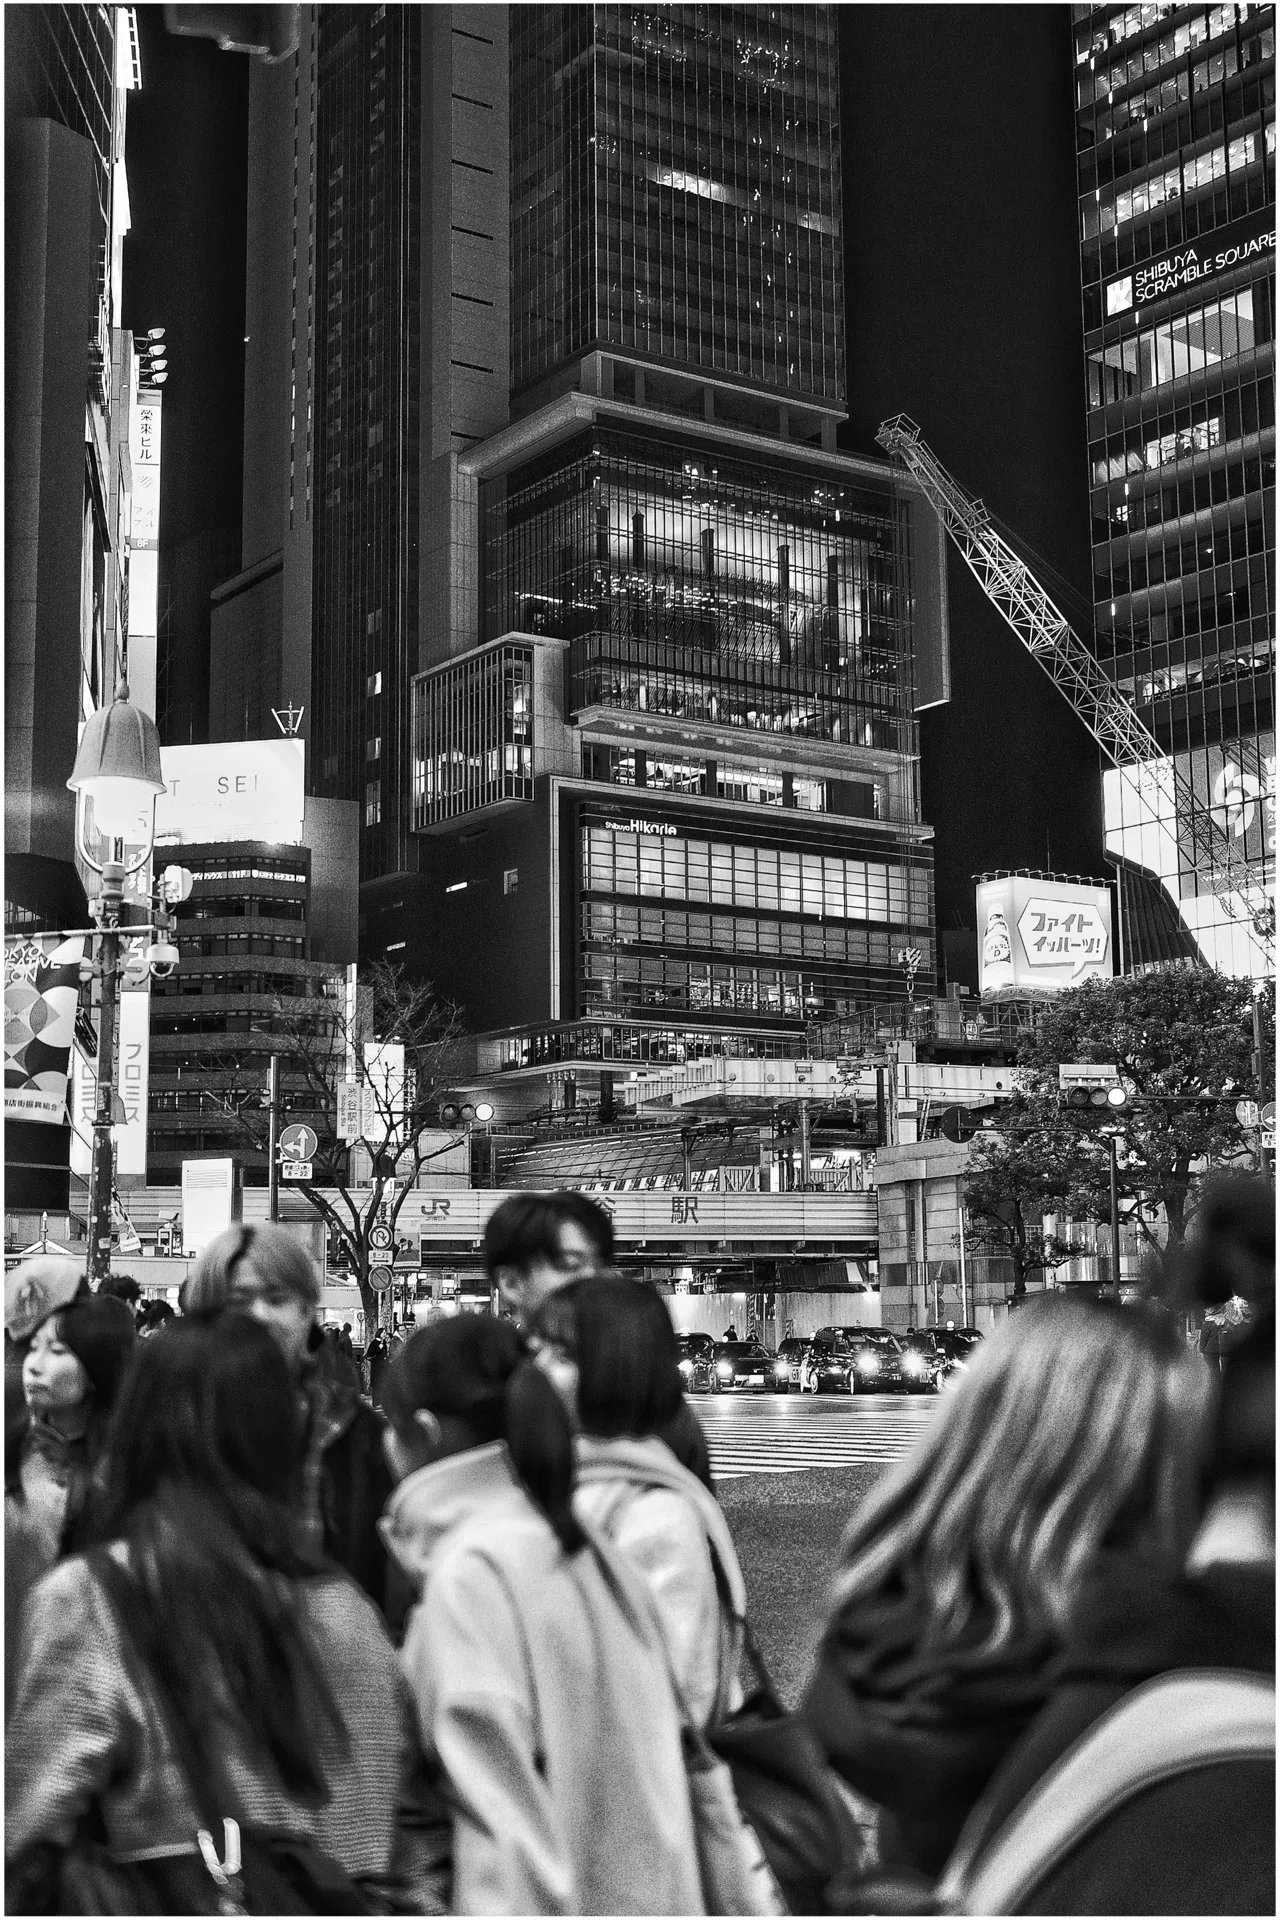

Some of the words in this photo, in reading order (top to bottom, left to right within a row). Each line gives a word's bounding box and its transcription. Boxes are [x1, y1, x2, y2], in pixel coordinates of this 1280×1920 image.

[1135, 249, 1198, 287] SHIBUYA
[1136, 258, 1213, 303] SCRAMBLE
[1215, 230, 1276, 270] SQUARE
[605, 821, 630, 832] Shibuya
[630, 819, 677, 836] Hikarie
[1030, 912, 1094, 933] ファイト
[81, 1064, 98, 1122] ロミス
[125, 1041, 143, 1123] プロミス
[347, 1088, 358, 1134] 渋谷駅前
[421, 1199, 450, 1215] JR
